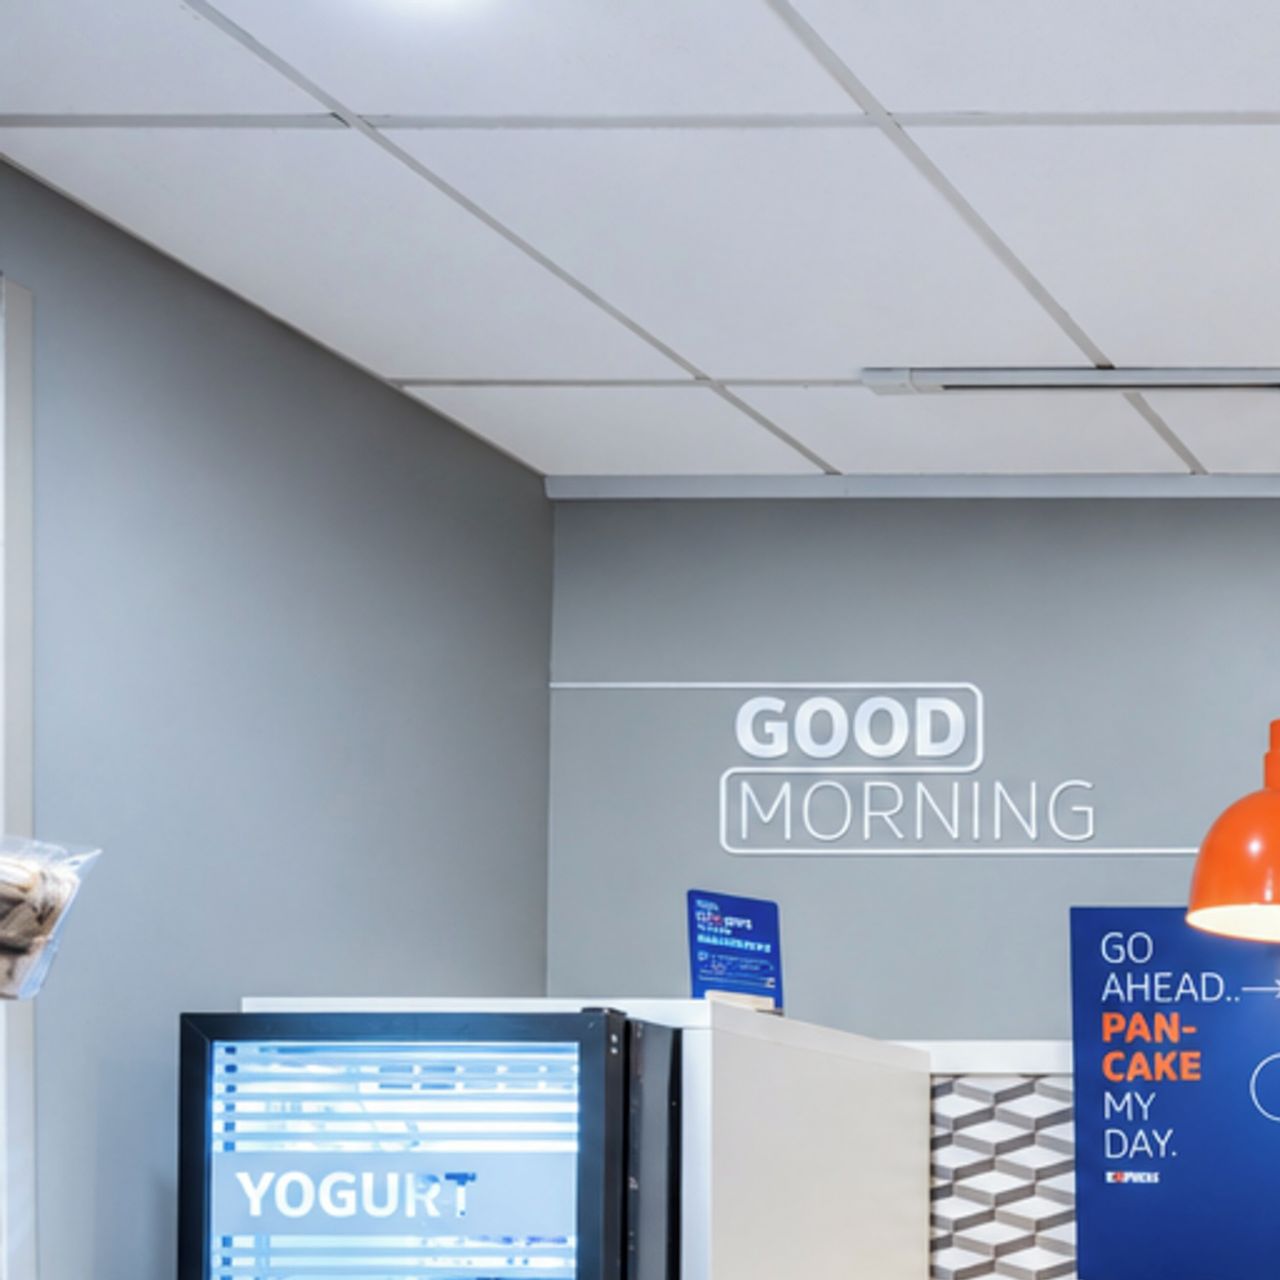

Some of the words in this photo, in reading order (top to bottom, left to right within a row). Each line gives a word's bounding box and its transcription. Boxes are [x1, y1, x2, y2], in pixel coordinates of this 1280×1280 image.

[735, 696, 966, 758] GOOD
[740, 780, 1095, 840] MORNING
[1101, 932, 1153, 964] GO
[1102, 1012, 1197, 1043] PAN-
[1102, 1050, 1201, 1082] CAKE
[1104, 1091, 1156, 1121] MY
[1104, 1129, 1178, 1159] DAY.
[235, 1171, 476, 1218] YOGURT
